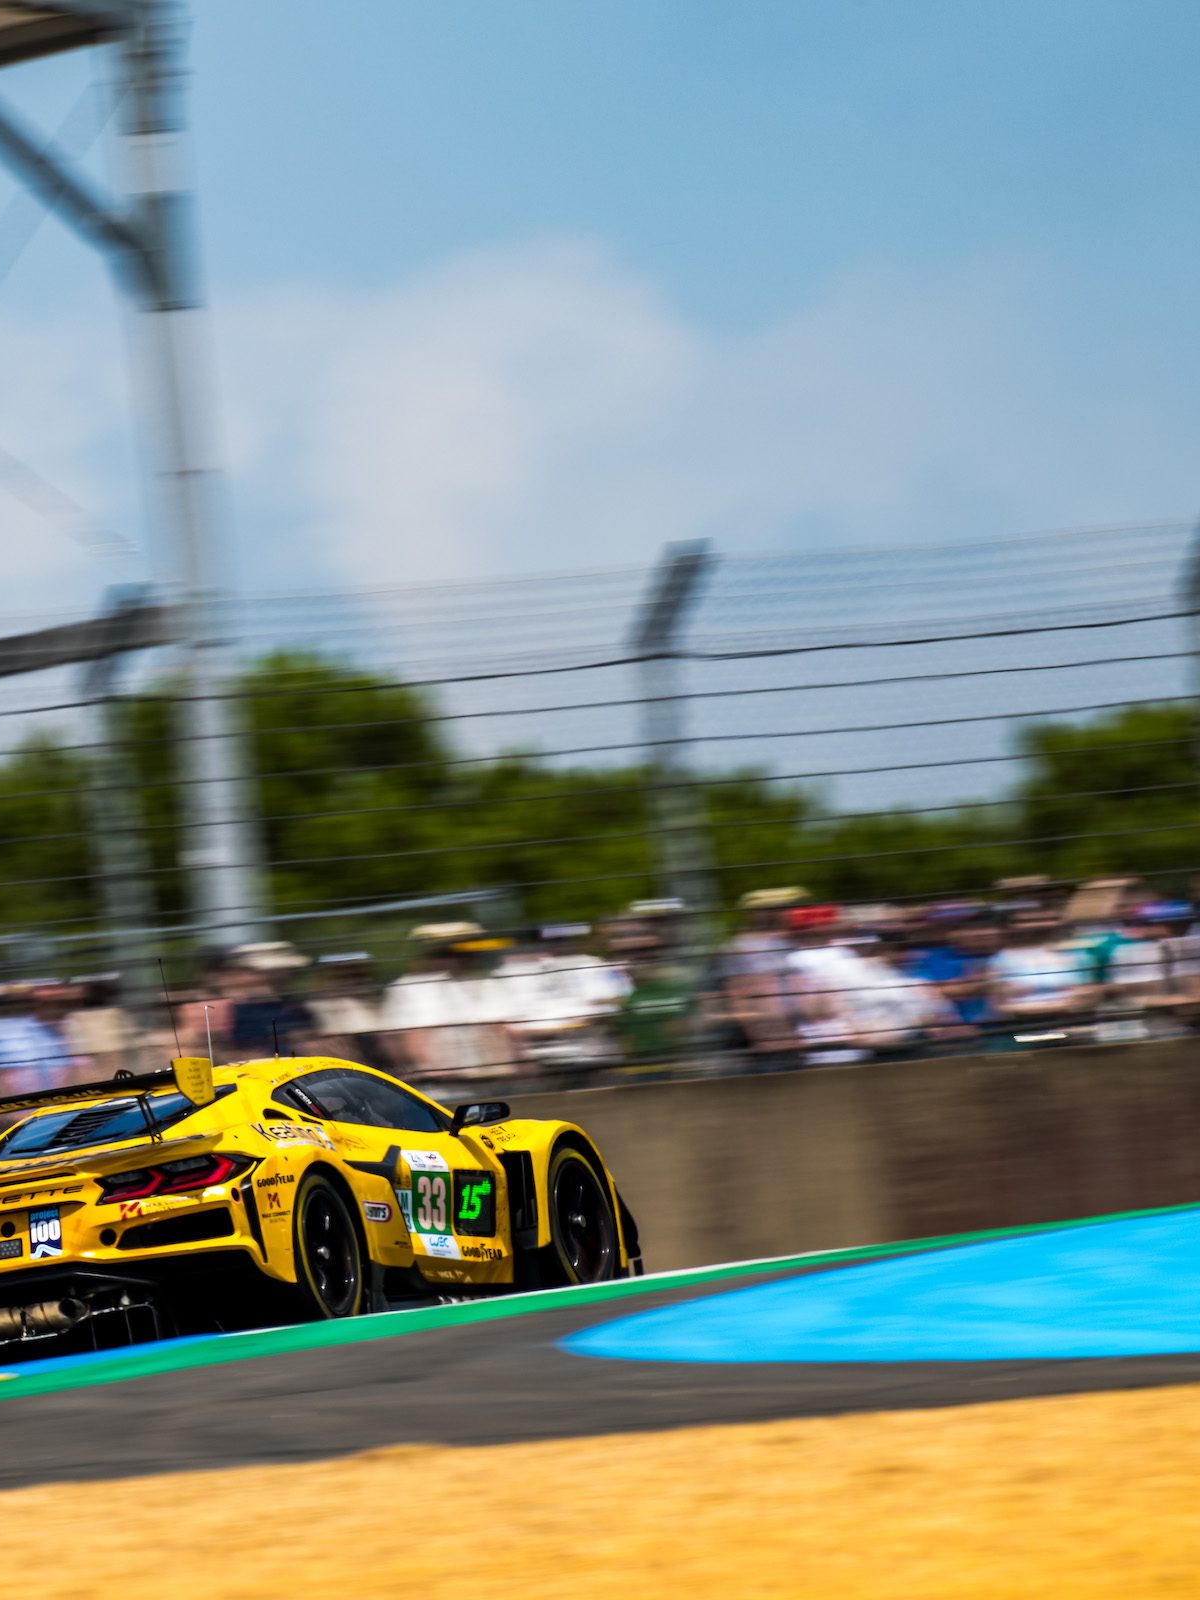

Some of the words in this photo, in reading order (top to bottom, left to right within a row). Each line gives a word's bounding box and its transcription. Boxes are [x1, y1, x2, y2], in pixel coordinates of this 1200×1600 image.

[295, 1088, 313, 1105] OPEN
[257, 1173, 295, 1188] GOODYEAR
[417, 1176, 447, 1231] 33
[30, 1208, 59, 1222] project
[29, 1219, 61, 1244] 100
[461, 1243, 504, 1261] GOODYEAR
